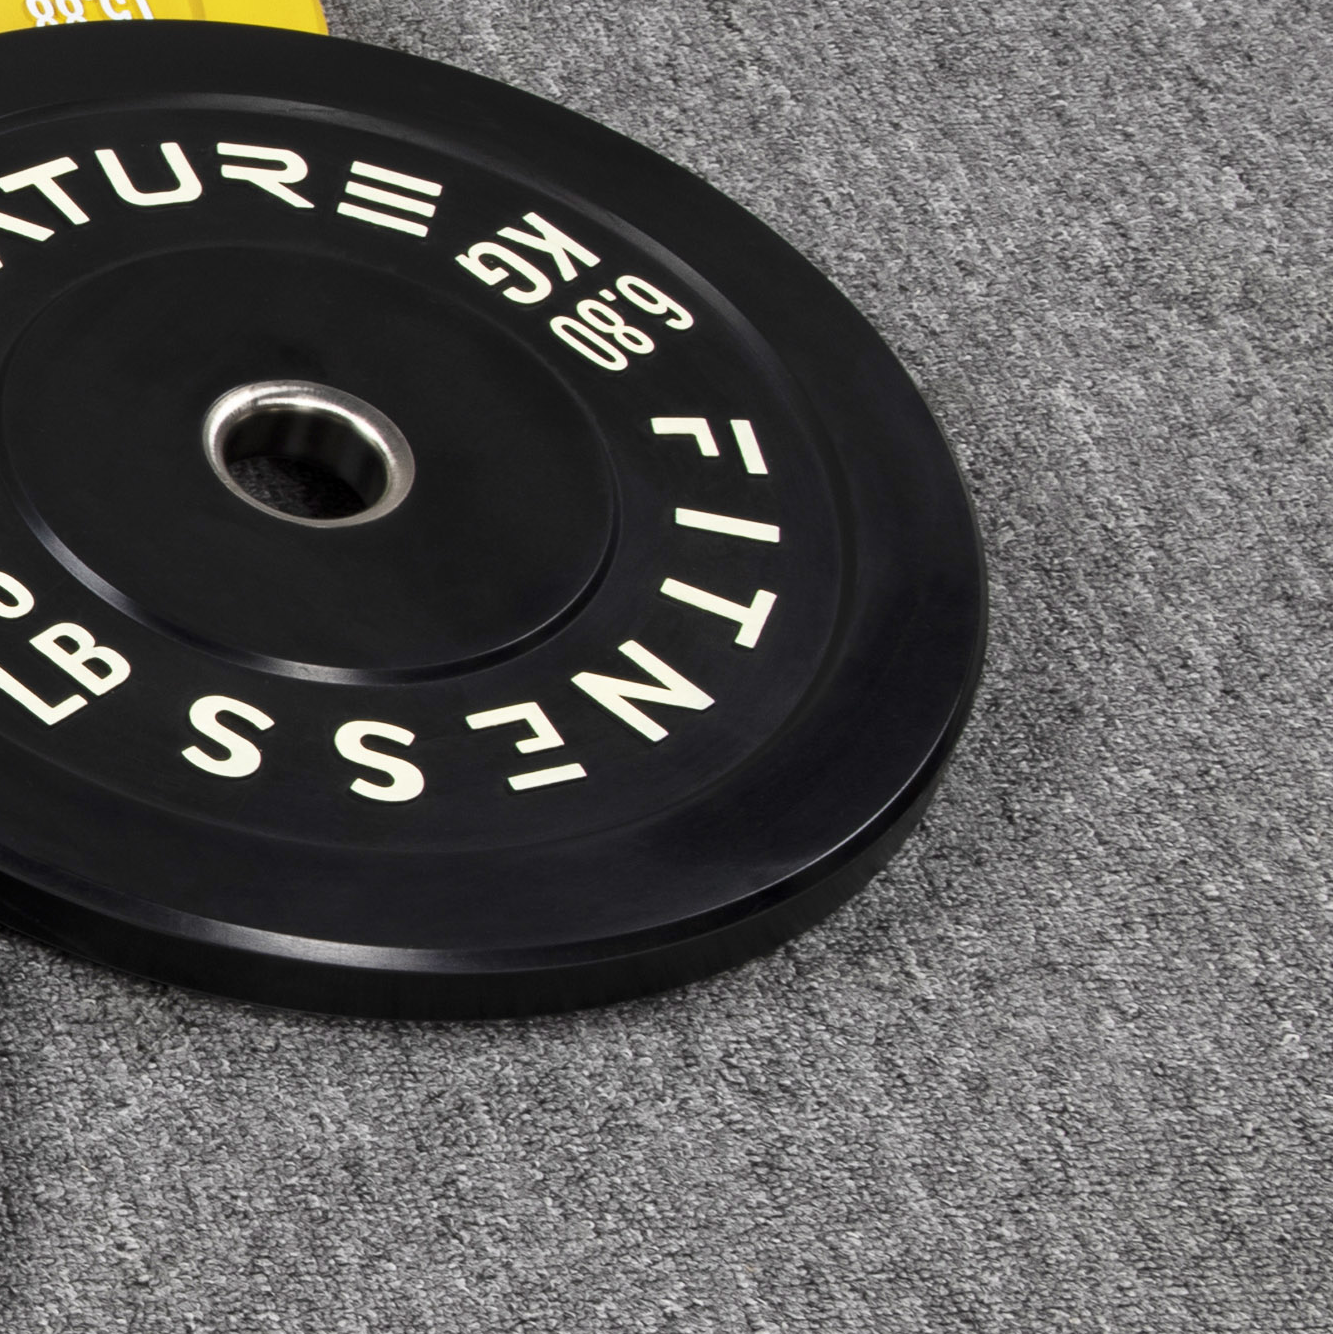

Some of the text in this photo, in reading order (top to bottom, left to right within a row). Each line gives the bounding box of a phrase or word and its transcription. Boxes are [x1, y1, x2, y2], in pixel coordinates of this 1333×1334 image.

[456, 211, 600, 305] KG
[549, 274, 695, 372] 6.80
[182, 417, 781, 803] FITNESS
